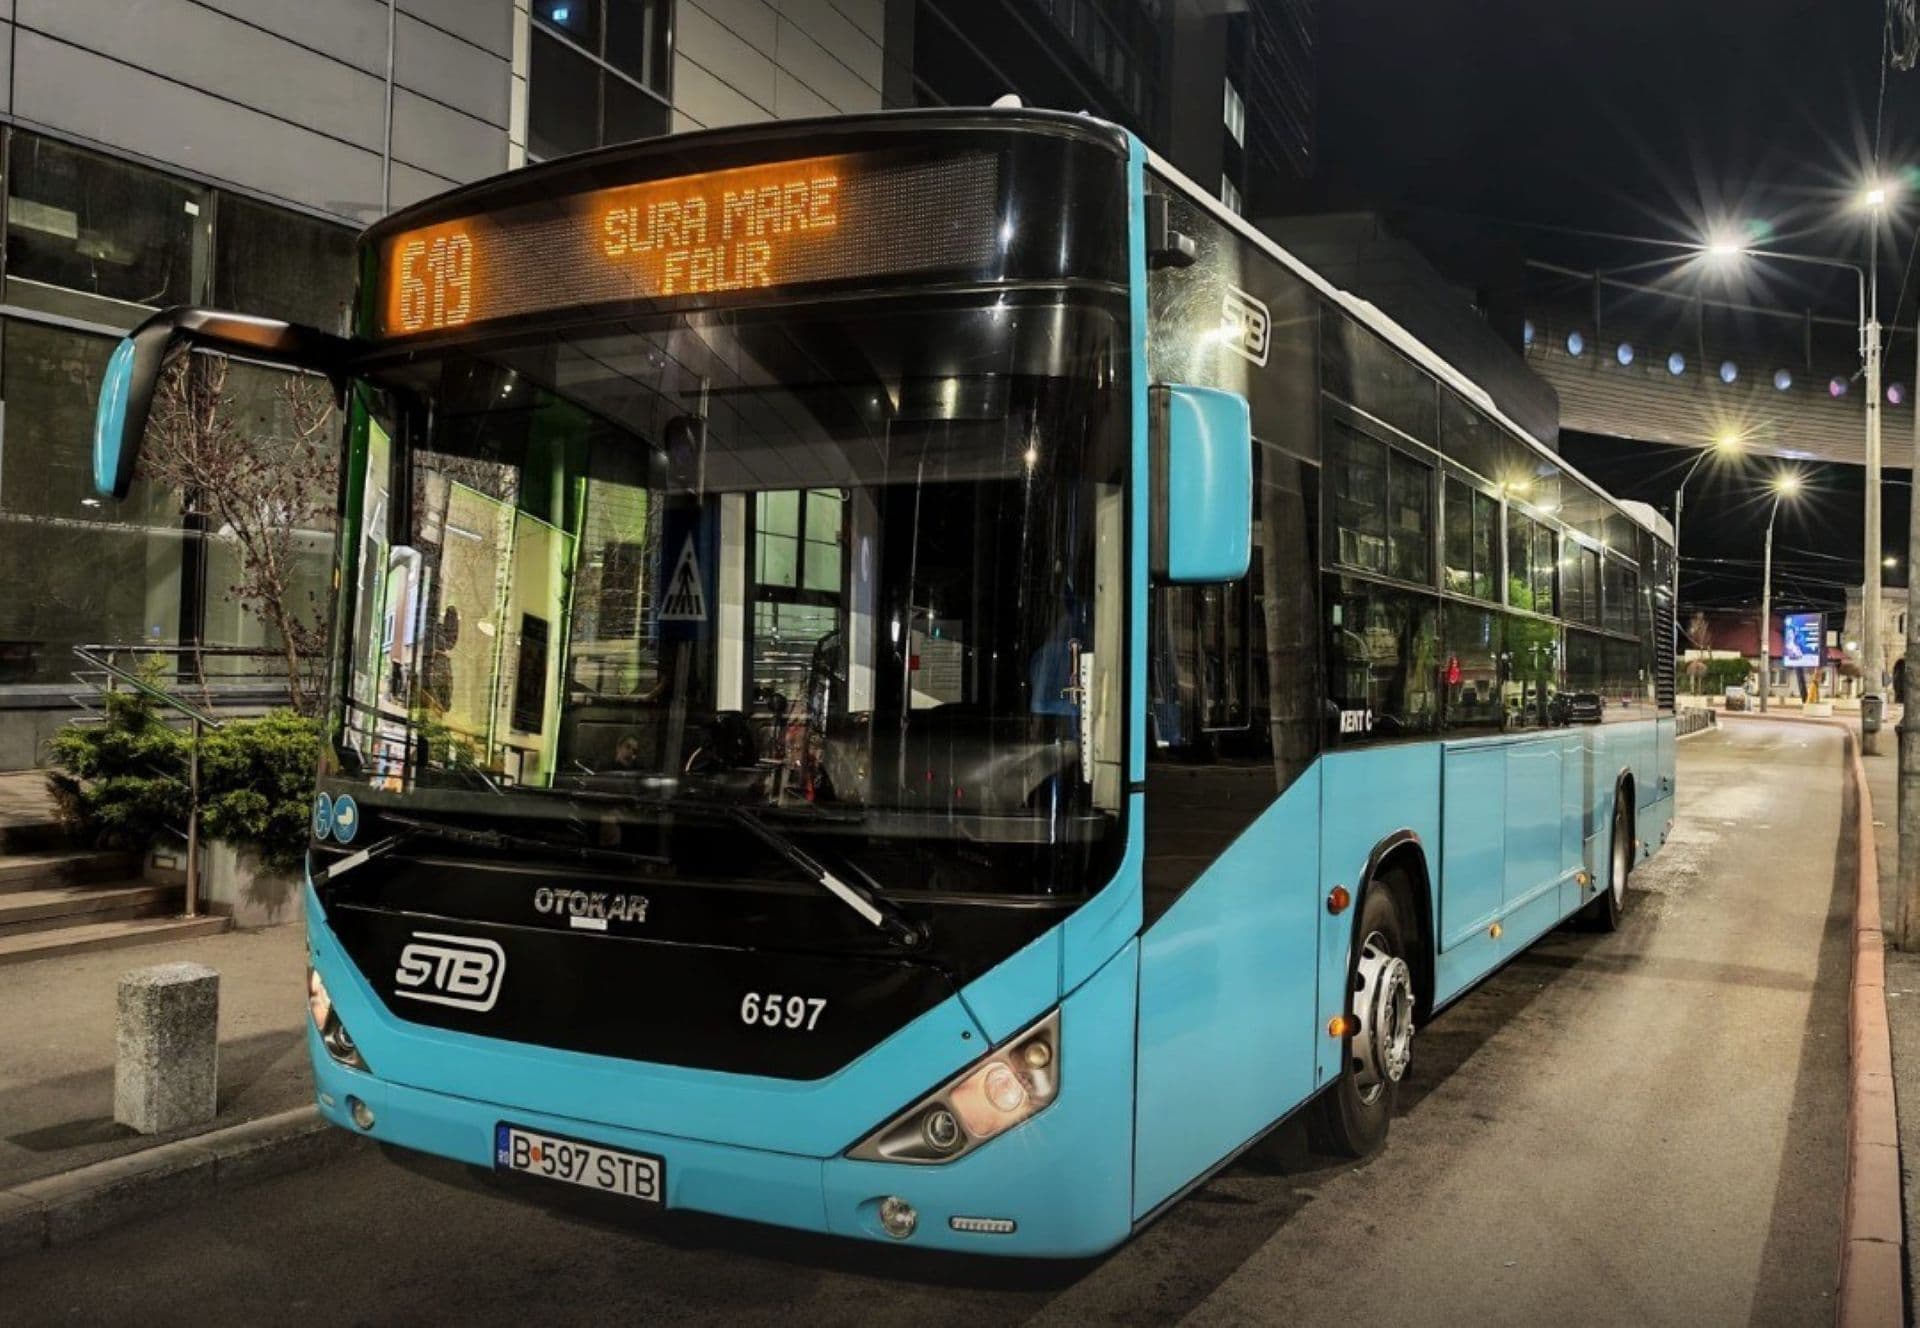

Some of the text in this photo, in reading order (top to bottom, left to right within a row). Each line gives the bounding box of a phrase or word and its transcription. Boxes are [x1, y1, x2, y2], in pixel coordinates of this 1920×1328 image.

[604, 176, 838, 255] SURA MARE
[400, 233, 472, 330] 619
[661, 240, 770, 295] FAUR
[1366, 709, 1372, 731] C
[534, 888, 649, 923] OTOKAR
[395, 943, 494, 996] STB
[741, 992, 827, 1031] 6597
[513, 1136, 655, 1197] B 597 STB
